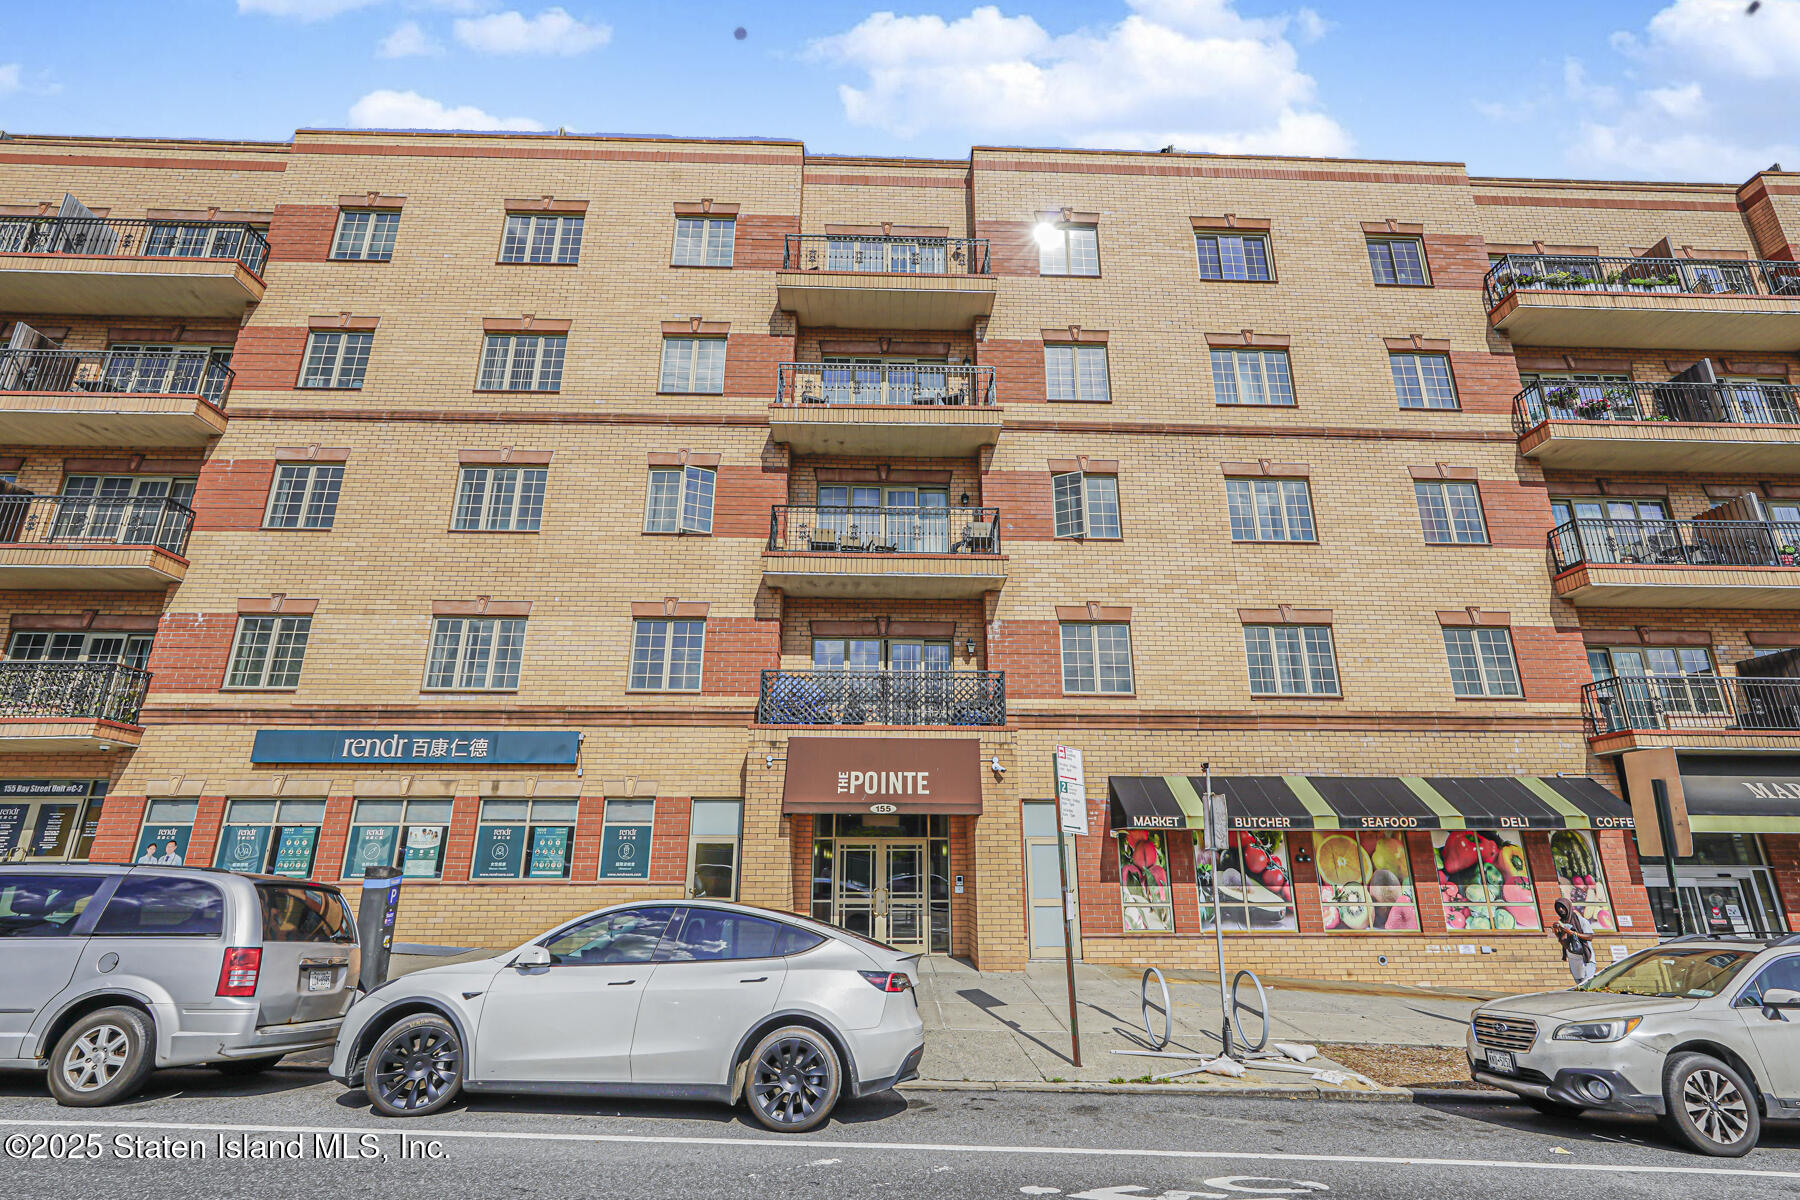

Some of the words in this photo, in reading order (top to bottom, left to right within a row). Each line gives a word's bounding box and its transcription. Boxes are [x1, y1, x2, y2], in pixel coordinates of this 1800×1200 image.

[341, 734, 408, 757] rendr
[412, 738, 489, 757] 百康仁德
[837, 771, 848, 794] THE
[849, 771, 930, 794] POINTE
[16, 785, 29, 793] Bay
[1133, 816, 1180, 827] MARKET
[1234, 816, 1291, 828] BUTCHER
[1361, 817, 1418, 828] SEAFOOD
[1501, 817, 1530, 828] DELI
[1596, 817, 1636, 828] COFFE
[157, 828, 178, 836] rendr
[237, 828, 257, 836] rendr
[366, 828, 384, 836] rendr
[493, 828, 512, 836] rendr
